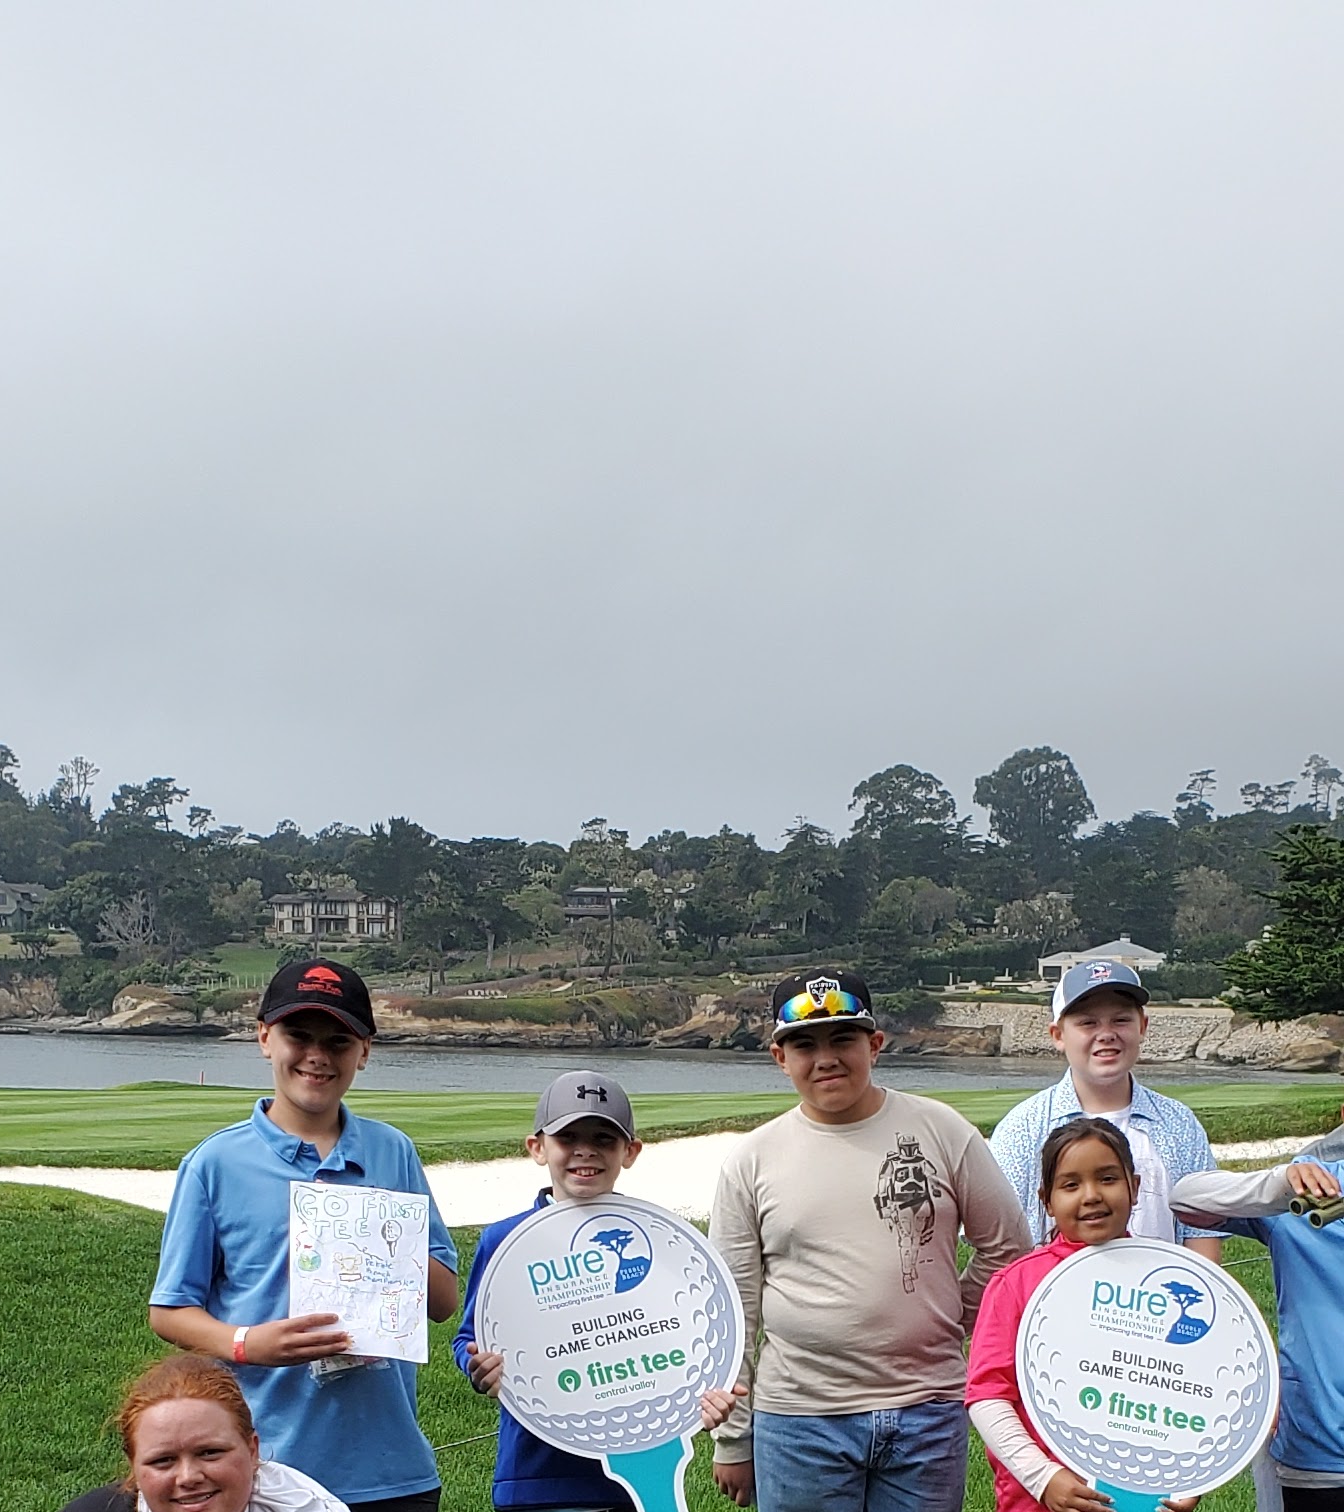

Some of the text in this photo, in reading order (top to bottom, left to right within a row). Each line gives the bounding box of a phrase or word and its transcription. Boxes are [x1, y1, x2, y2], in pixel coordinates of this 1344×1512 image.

[299, 1194, 349, 1220] GO
[312, 1217, 371, 1239] TEE
[527, 1250, 604, 1295] pure
[541, 1273, 608, 1294] INSURANCE
[537, 1281, 611, 1305] CHAMPIONSHIP
[1092, 1280, 1167, 1316] pure
[572, 1308, 645, 1335] BUILDING
[1091, 1313, 1164, 1335] CHAMPIONSHIP
[1098, 1306, 1164, 1325] INSURANCE
[545, 1317, 681, 1358] GAME CHANGERS
[587, 1349, 686, 1387] first tee
[1112, 1350, 1184, 1375] BUILDING
[595, 1379, 656, 1400] central valley
[1079, 1360, 1213, 1399] GAME CHANGERS
[1108, 1392, 1206, 1433] first tee
[1107, 1420, 1170, 1441] central valley
